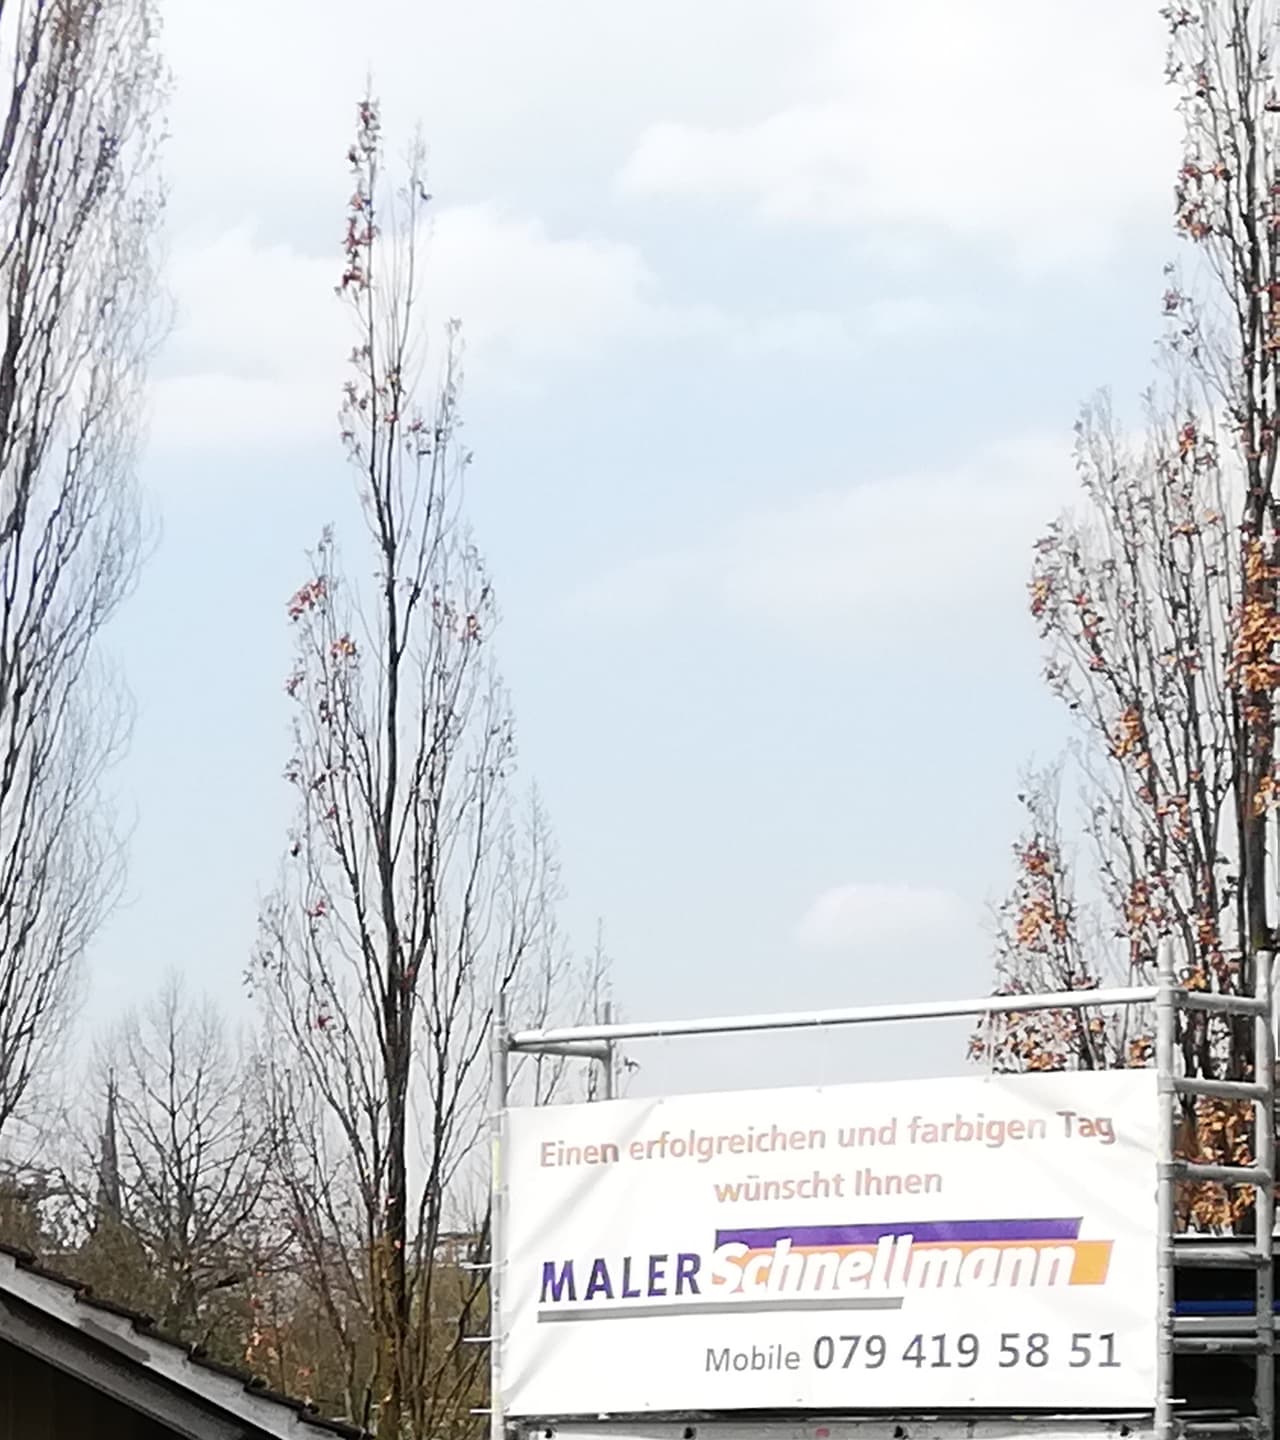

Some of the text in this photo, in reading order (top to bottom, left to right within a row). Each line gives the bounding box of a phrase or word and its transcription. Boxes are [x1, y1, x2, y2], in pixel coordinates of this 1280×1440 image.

[539, 1109, 1117, 1168] Einen erfolgreichen und farbigen Tag
[713, 1167, 943, 1203] wünscht Ihnen
[538, 1233, 1077, 1302] MALER Schnellmann
[704, 1331, 1123, 1373] Mobile 079 419 58 51
